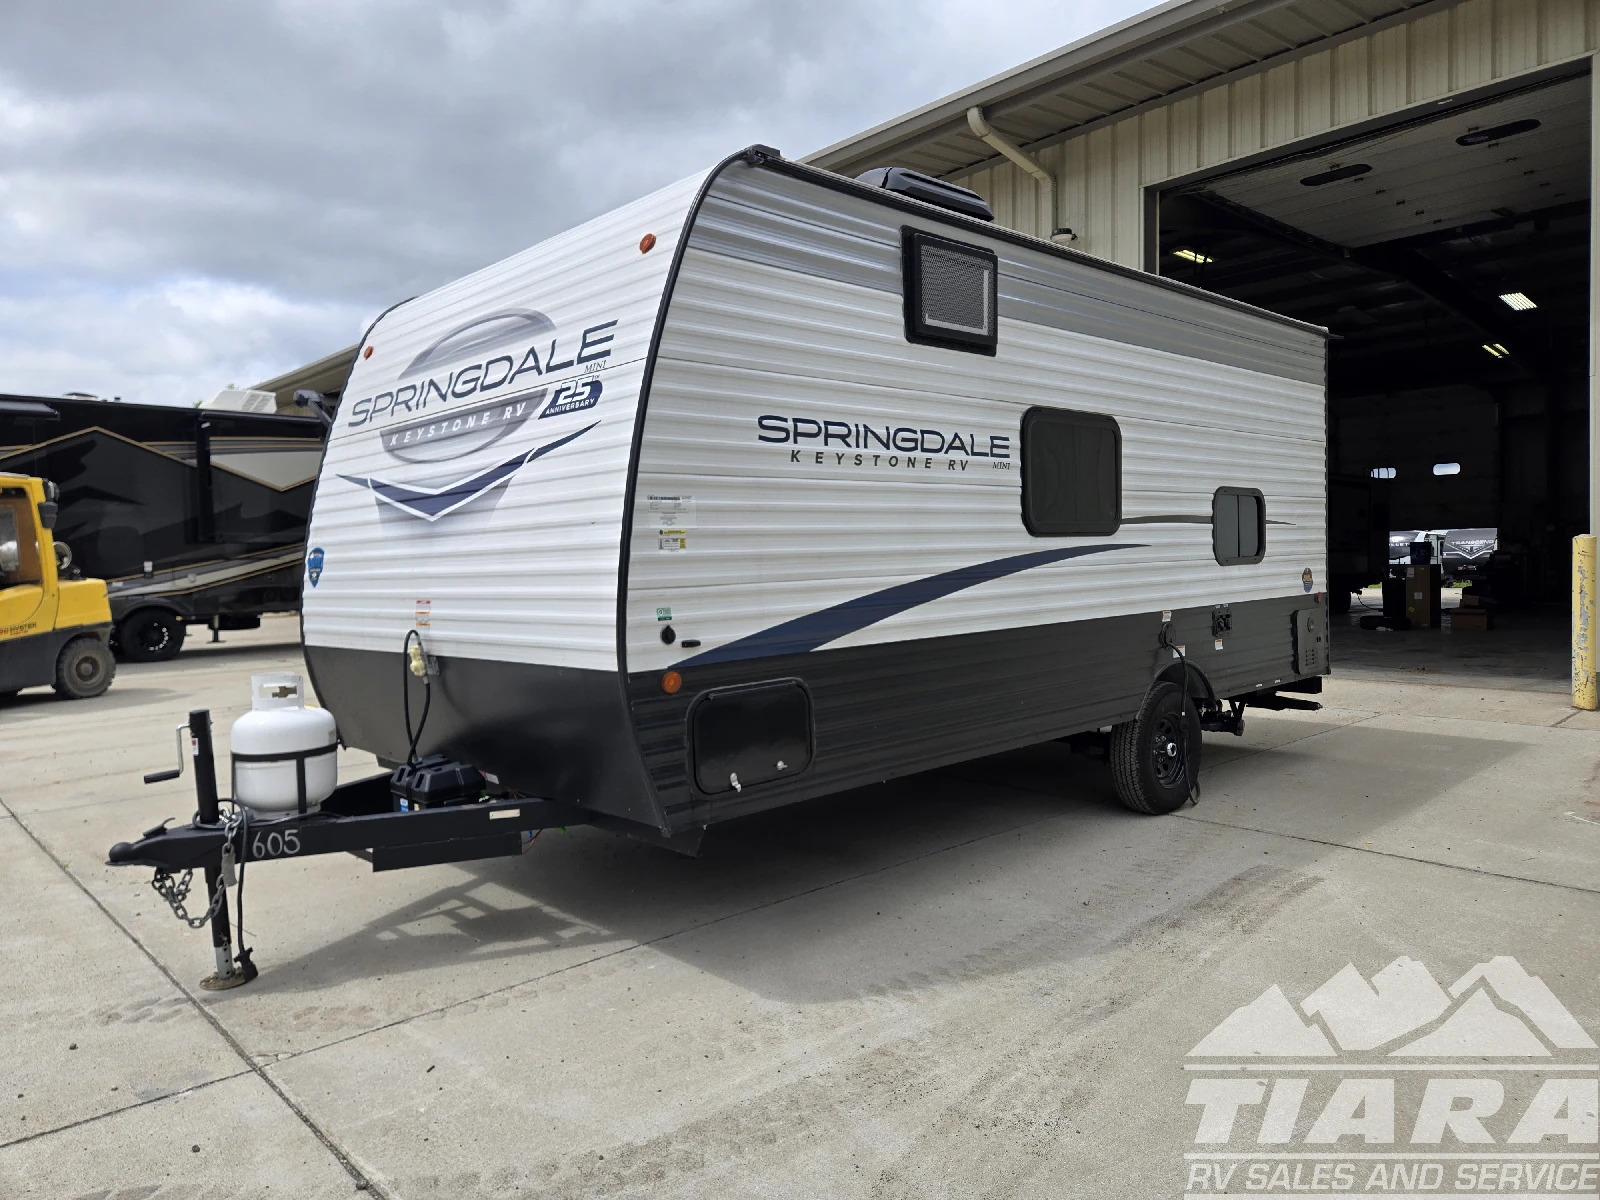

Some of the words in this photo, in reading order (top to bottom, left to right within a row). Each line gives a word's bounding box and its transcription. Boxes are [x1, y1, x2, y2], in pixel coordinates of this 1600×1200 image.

[348, 319, 619, 427] SPRINGDALE
[584, 360, 607, 373] MINI
[545, 398, 595, 415] ANNIVERSARY
[389, 411, 491, 447] KEYSTONE
[502, 402, 527, 420] RV
[757, 414, 1011, 459] SPRINGDALE
[790, 450, 933, 469] KEYSTONE
[948, 460, 969, 471] RV
[992, 461, 1011, 471] MINI
[252, 829, 301, 859] 605
